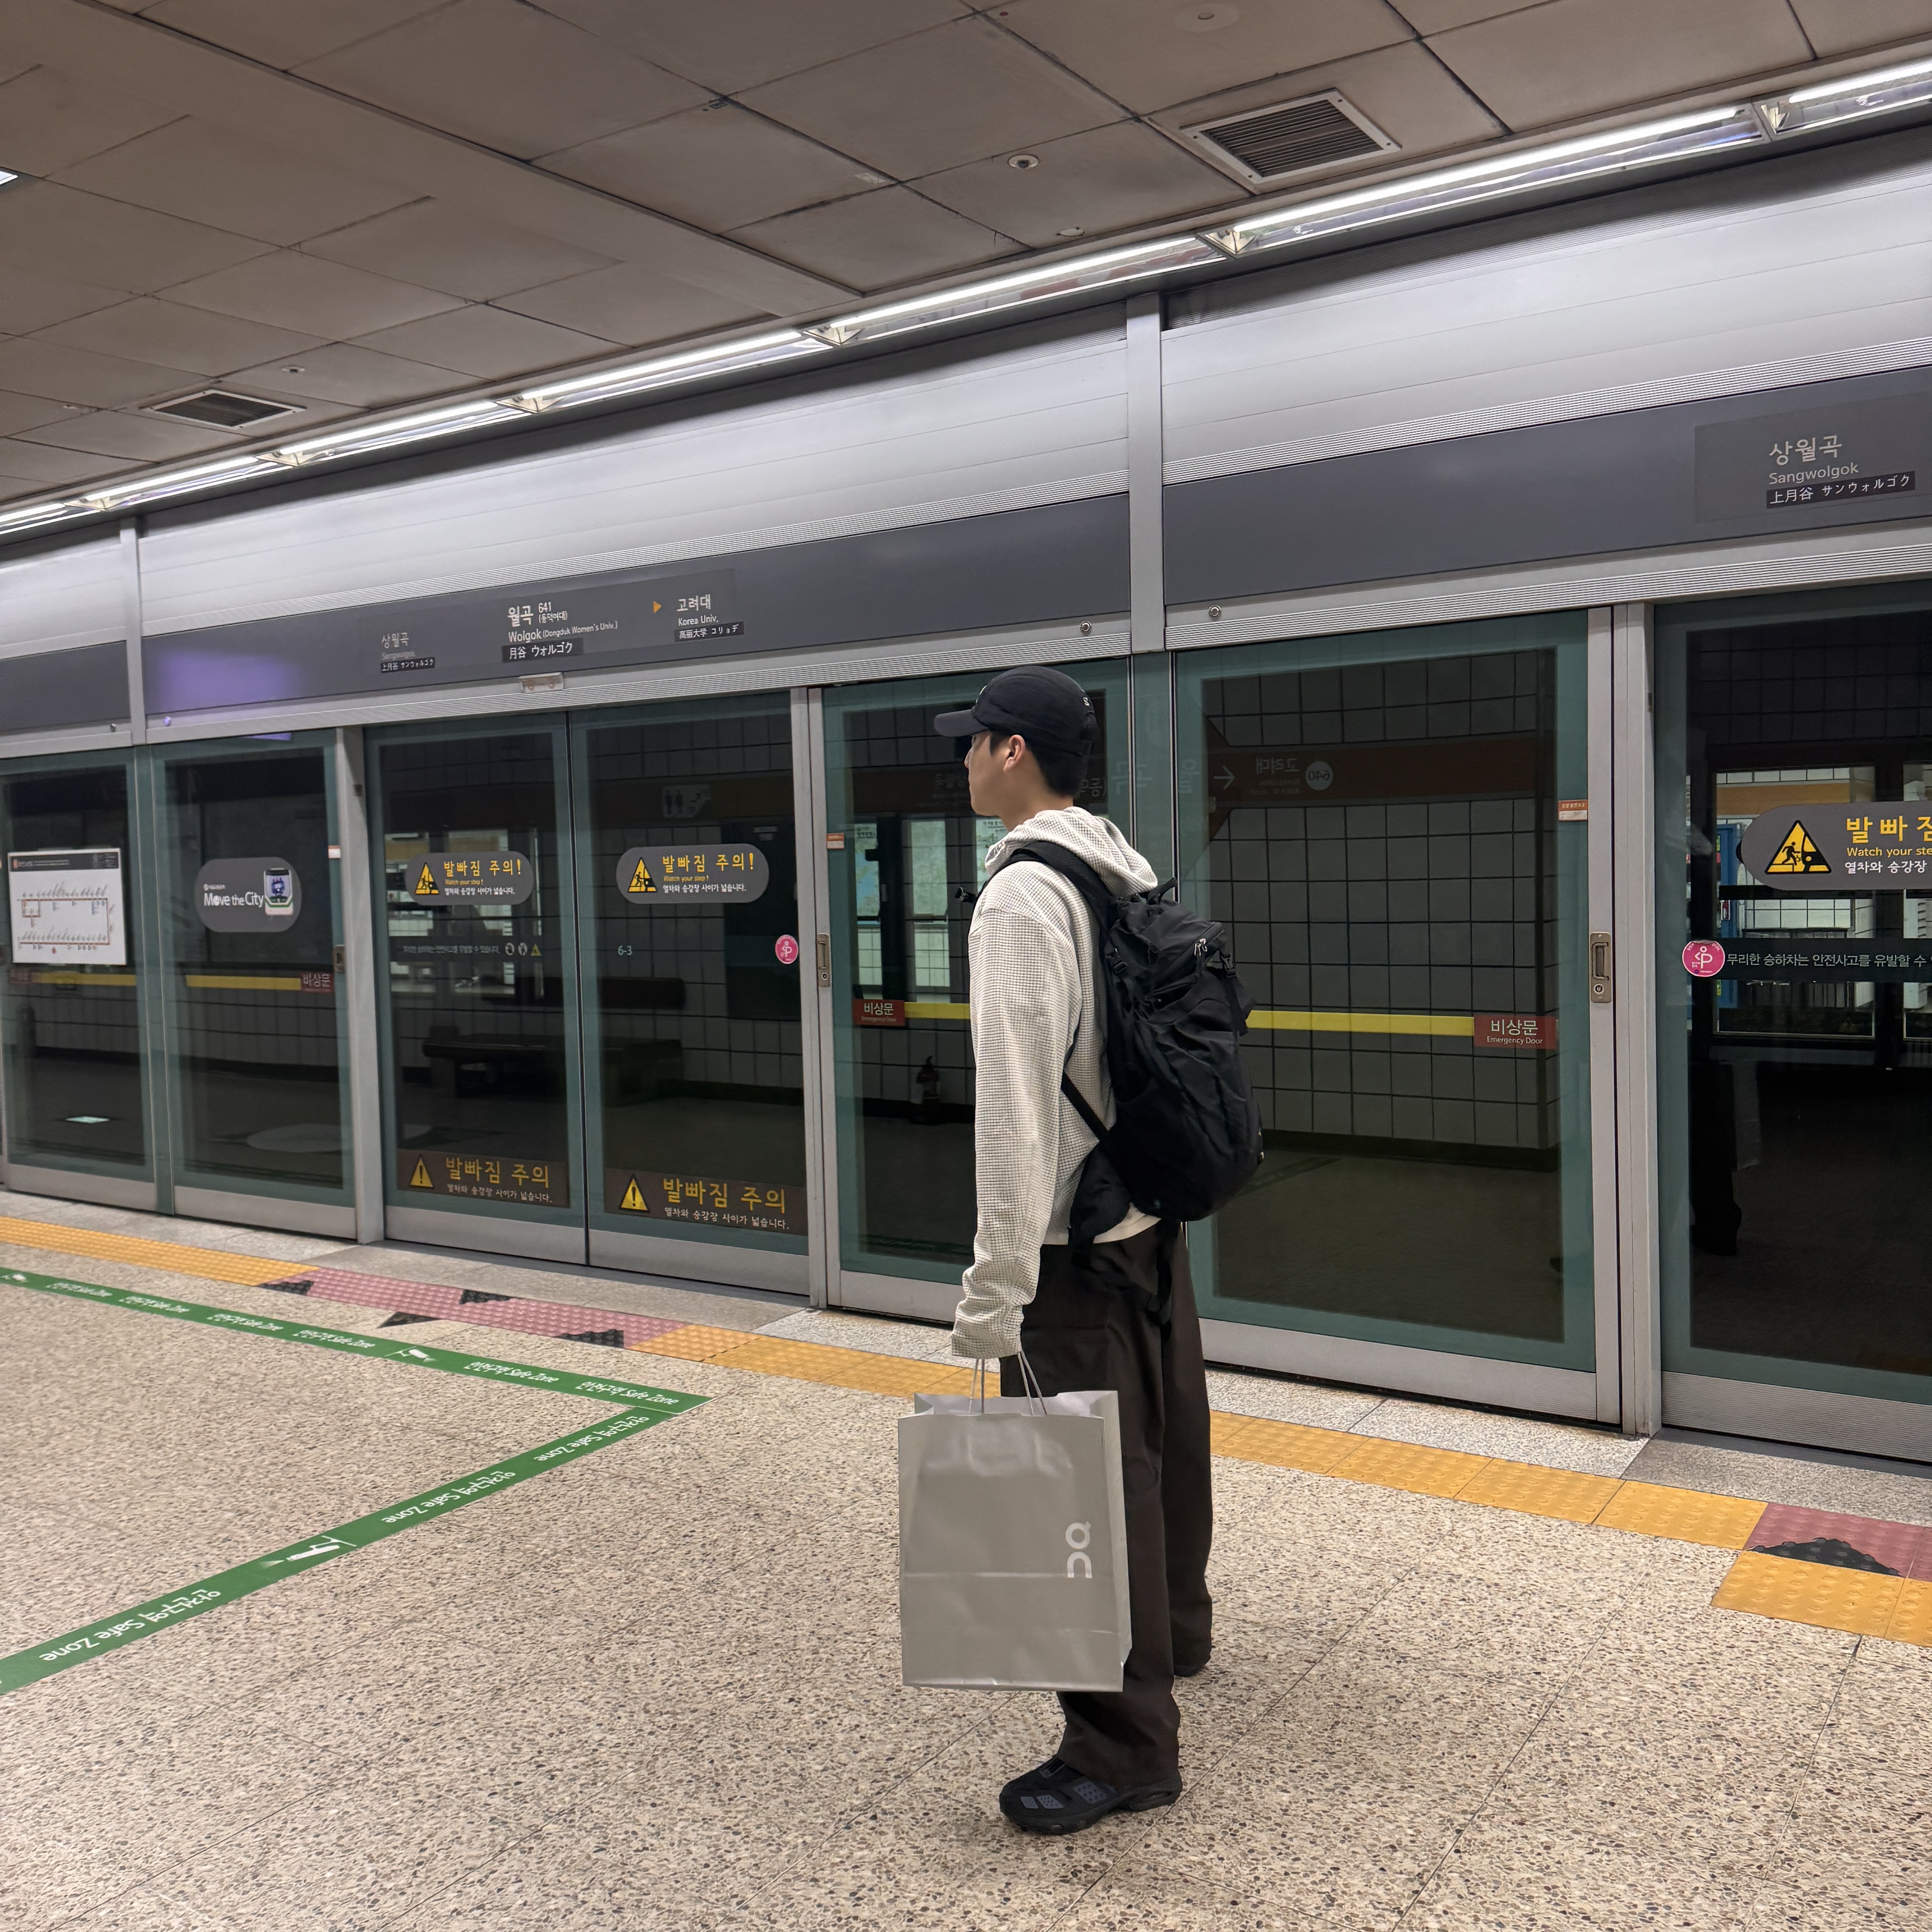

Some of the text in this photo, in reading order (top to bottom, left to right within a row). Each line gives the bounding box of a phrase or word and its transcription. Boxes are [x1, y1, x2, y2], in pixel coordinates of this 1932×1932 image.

[1769, 435, 1842, 465] 상월곡
[1769, 462, 1858, 484] Sangwolgok
[1770, 487, 1814, 504] 上月谷
[676, 594, 711, 612] 고려대
[508, 602, 552, 627] 월곡 641
[678, 614, 719, 626] Korea Univ.
[382, 632, 409, 649] 상월곡
[508, 629, 542, 643] Wolgok
[510, 646, 527, 659] 月谷
[1847, 847, 1882, 856] Watch
[1886, 849, 1913, 858] your
[444, 860, 480, 877] 발빠짐
[662, 855, 704, 873] 발빠짐
[1845, 860, 1927, 874] 열차와 승강장
[204, 892, 264, 907] Move the City
[618, 945, 632, 955] 6-3
[1727, 953, 1927, 968] 무리한 승하차는 안전사고를 유발할 수
[864, 1002, 893, 1015] 비상문
[1491, 1019, 1538, 1035] 비상문
[1487, 1036, 1524, 1044] Emergency
[445, 1157, 548, 1188] 발빠짐 주의
[663, 1178, 785, 1214] 발빠짐 주의
[722, 1214, 747, 1225] 사이가
[528, 1373, 559, 1383] Zone
[620, 1389, 649, 1399] Safe
[646, 1394, 679, 1405] Zone
[566, 1435, 603, 1446] Safe
[534, 1446, 575, 1461] Zone
[420, 1493, 460, 1506] Safe
[381, 1506, 428, 1523] Zone
[94, 1619, 145, 1637] Safe
[39, 1638, 100, 1661] Zone
